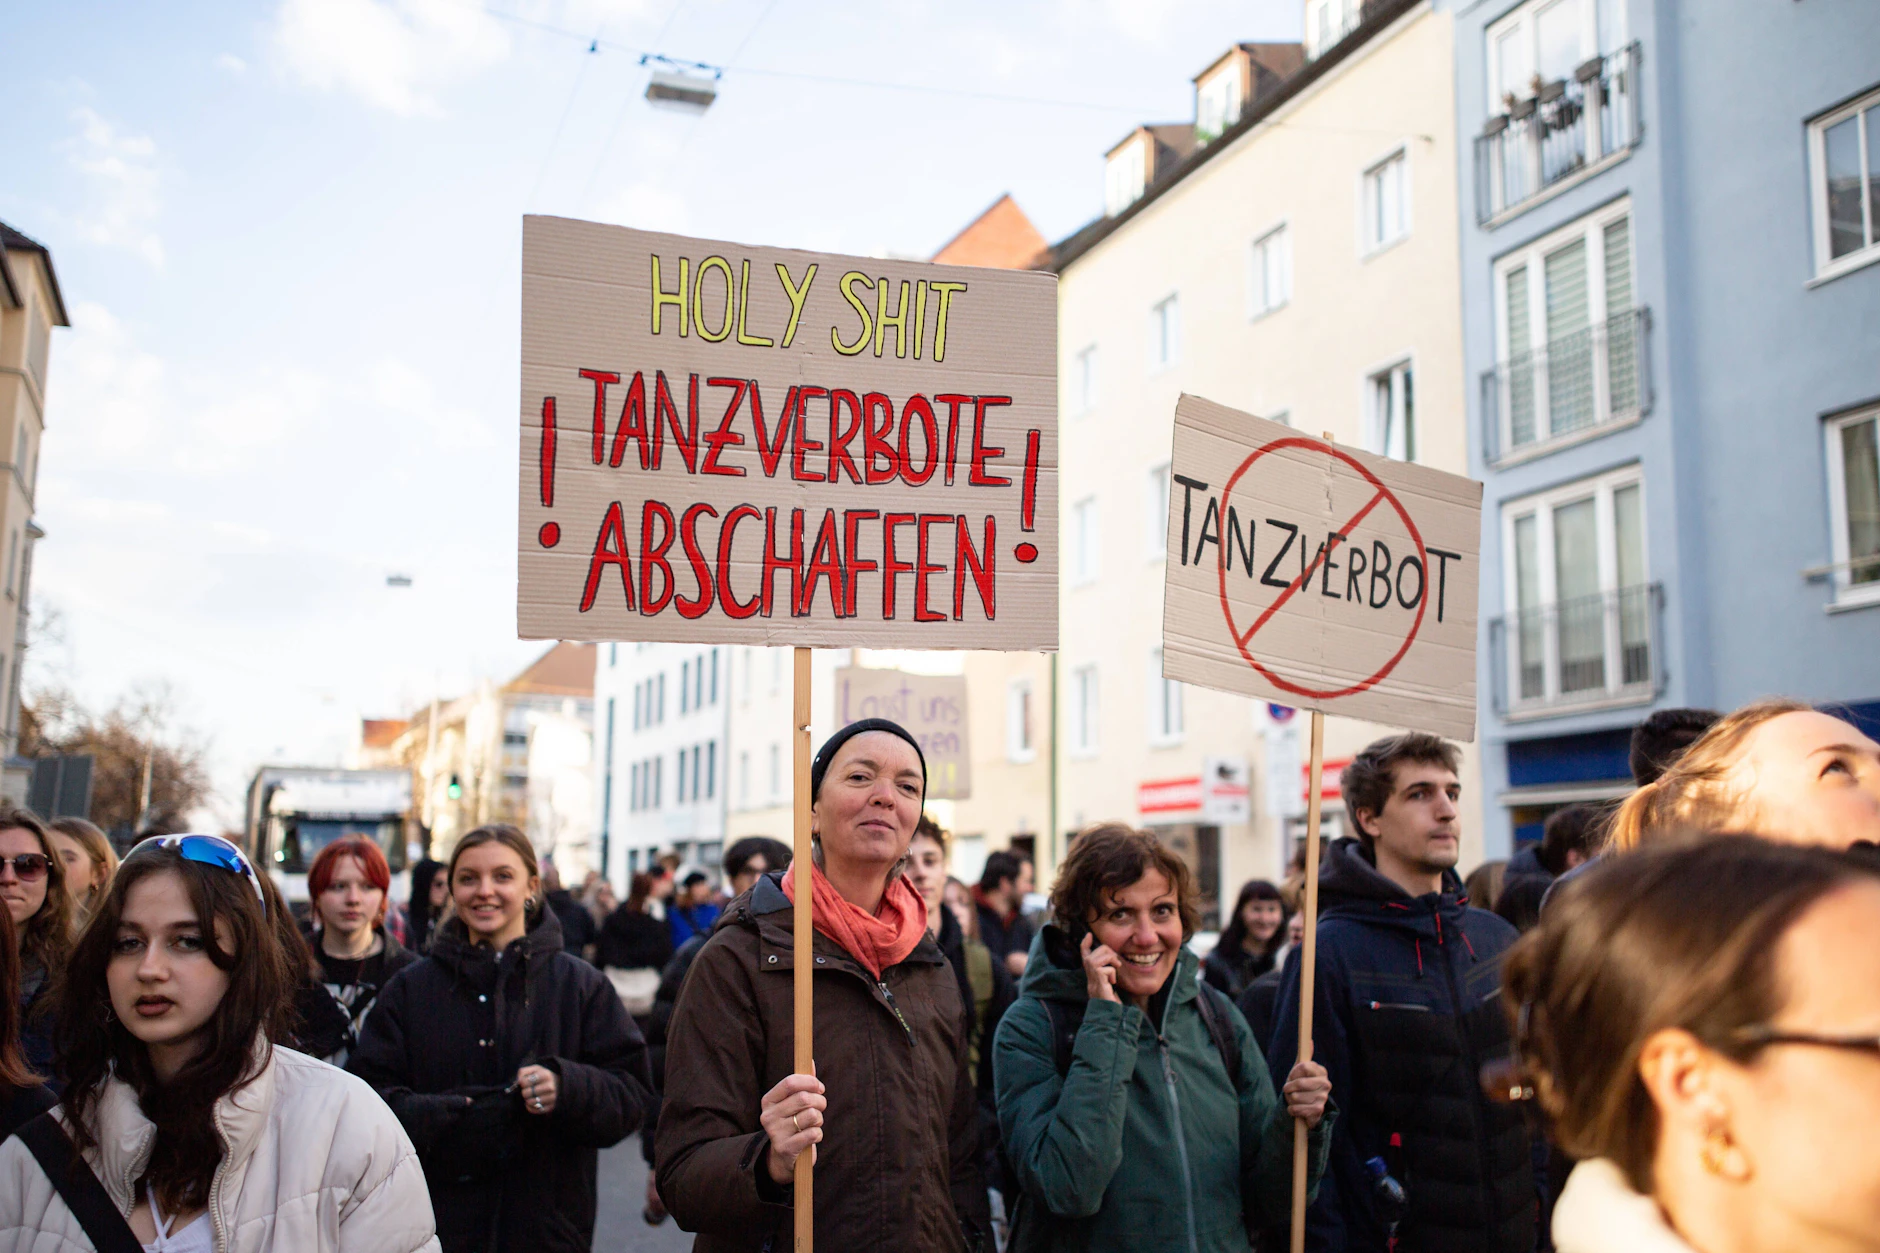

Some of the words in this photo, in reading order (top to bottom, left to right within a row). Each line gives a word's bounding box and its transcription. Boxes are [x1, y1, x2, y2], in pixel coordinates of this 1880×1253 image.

[651, 254, 818, 348] HOLY
[831, 271, 967, 362] SHIT
[578, 368, 1013, 487] TANZVERBOTE
[579, 499, 996, 622] ABSCHAFFEN
[1173, 474, 1462, 623] TANZVERBOT
